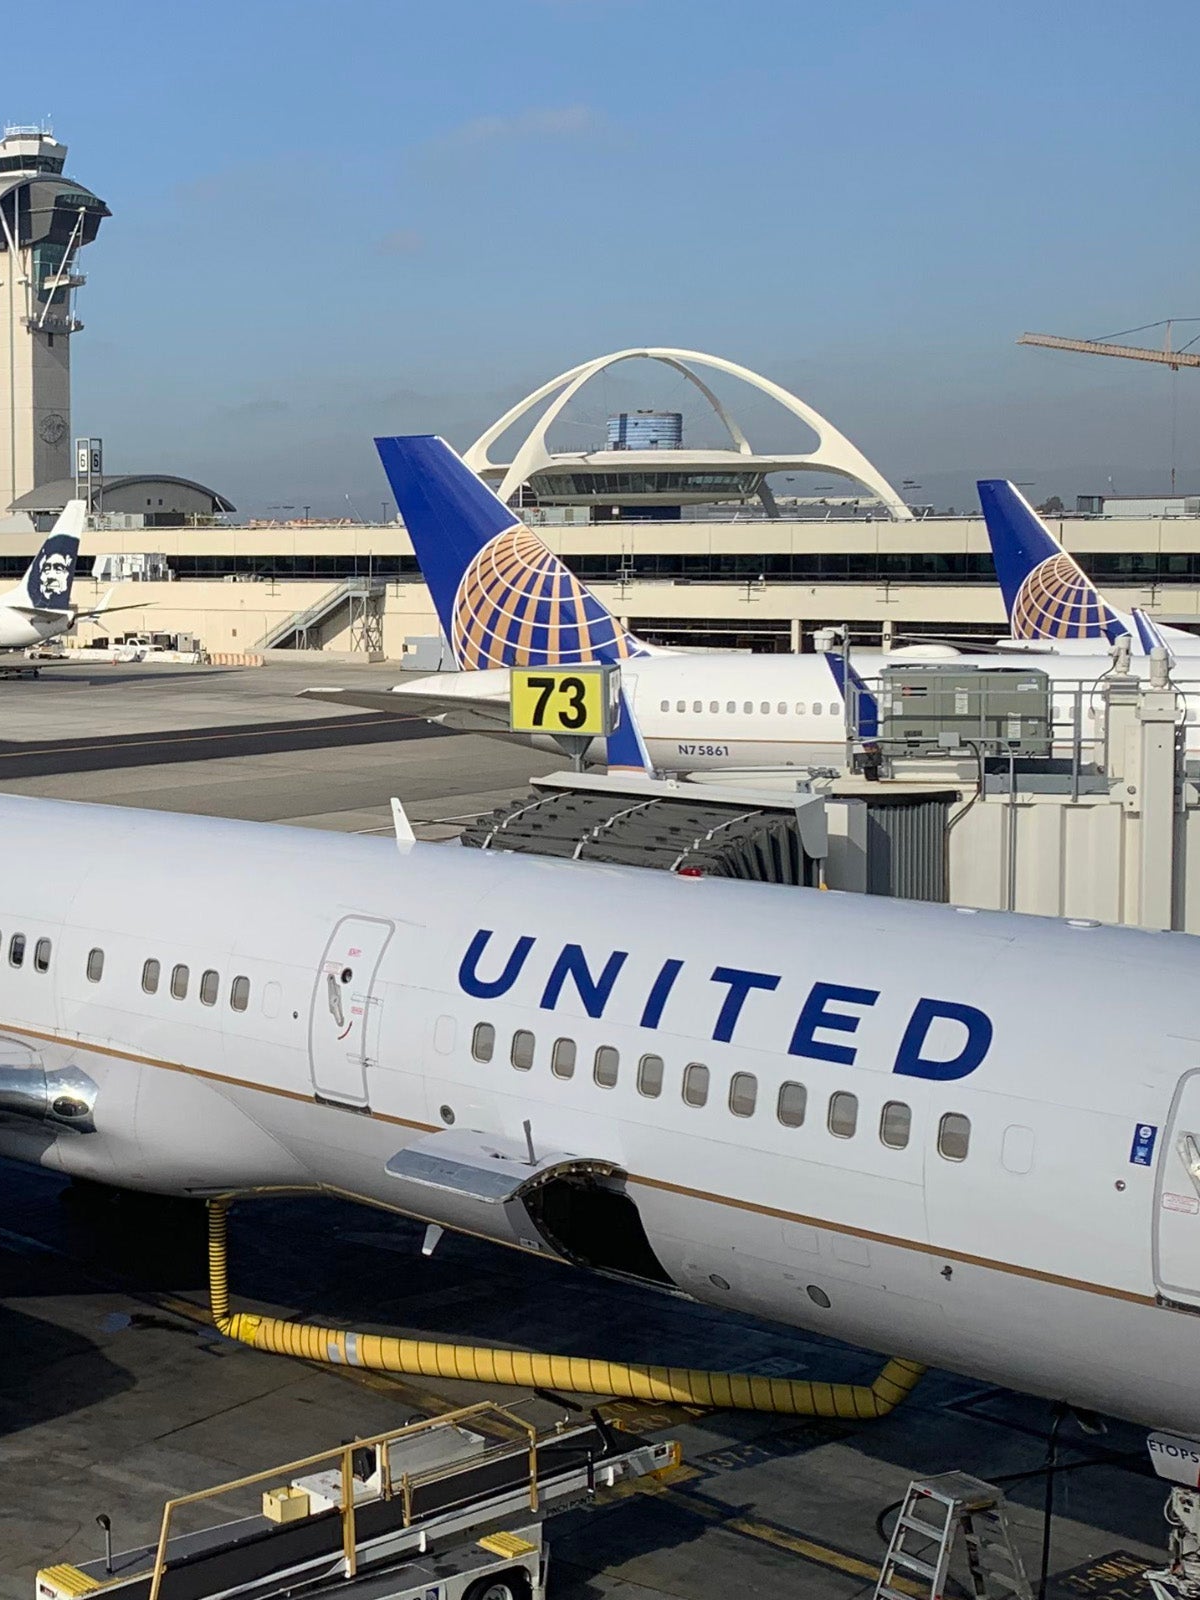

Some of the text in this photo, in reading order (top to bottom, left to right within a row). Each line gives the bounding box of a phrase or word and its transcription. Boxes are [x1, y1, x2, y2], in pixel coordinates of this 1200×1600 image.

[80, 453, 86, 468] 6
[527, 677, 587, 730] 73
[679, 744, 729, 757] N75861
[458, 929, 994, 1081] UNITED
[1150, 1440, 1200, 1464] ETOPS
